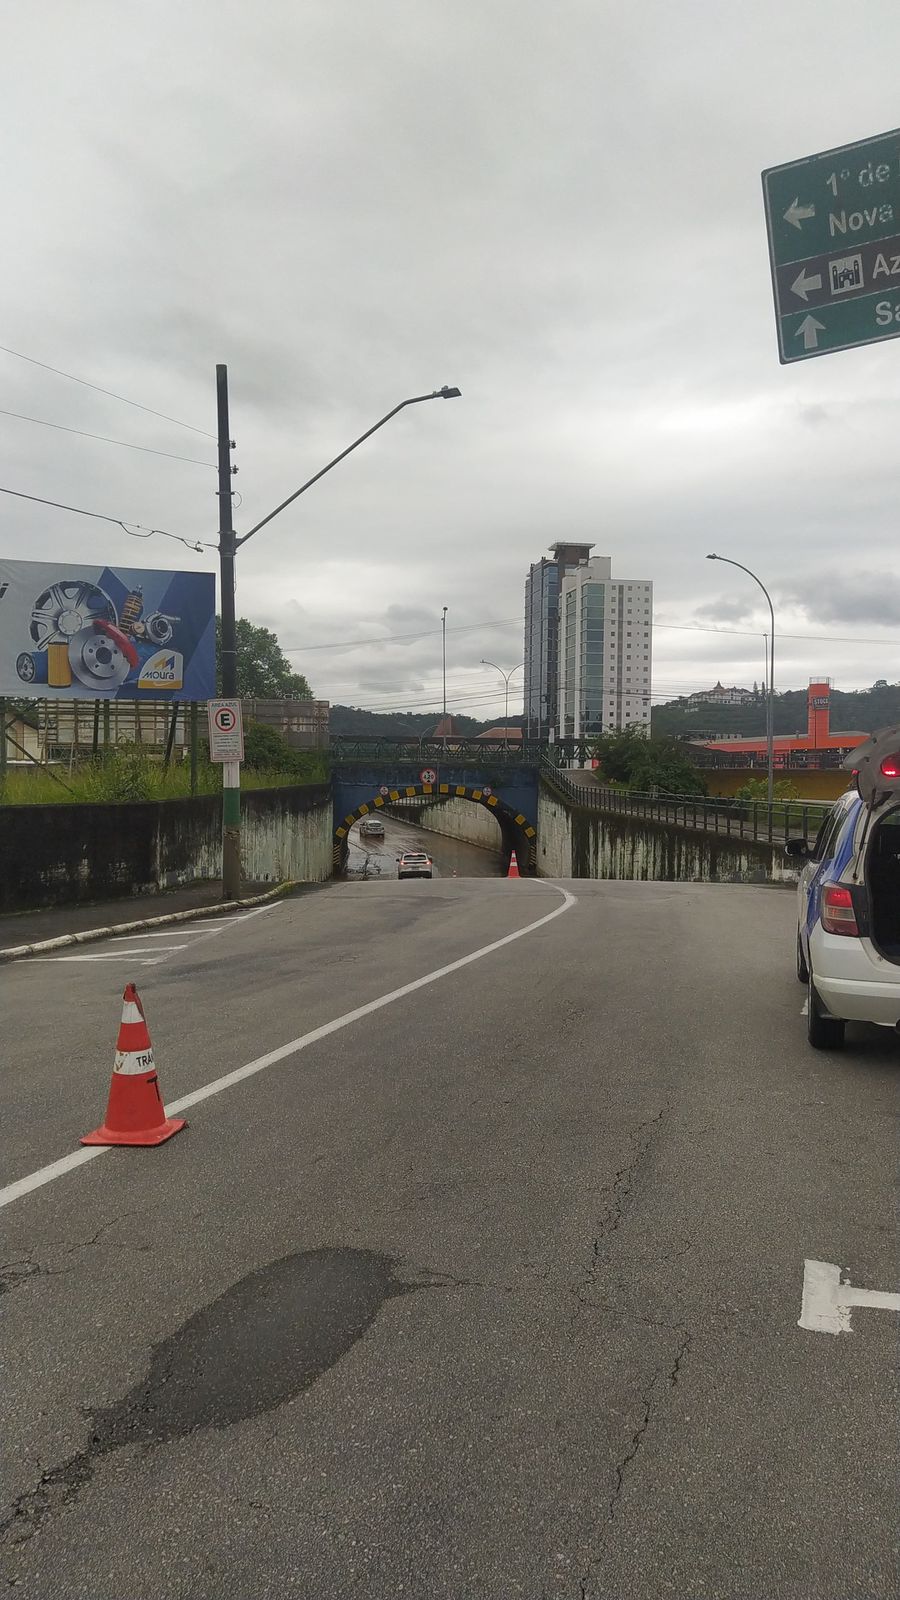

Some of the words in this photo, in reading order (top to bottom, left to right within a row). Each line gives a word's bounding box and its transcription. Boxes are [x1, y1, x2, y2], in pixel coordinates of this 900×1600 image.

[858, 161, 890, 187] de
[828, 203, 894, 237] Nova
[872, 253, 900, 279] Az
[220, 713, 231, 726] E
